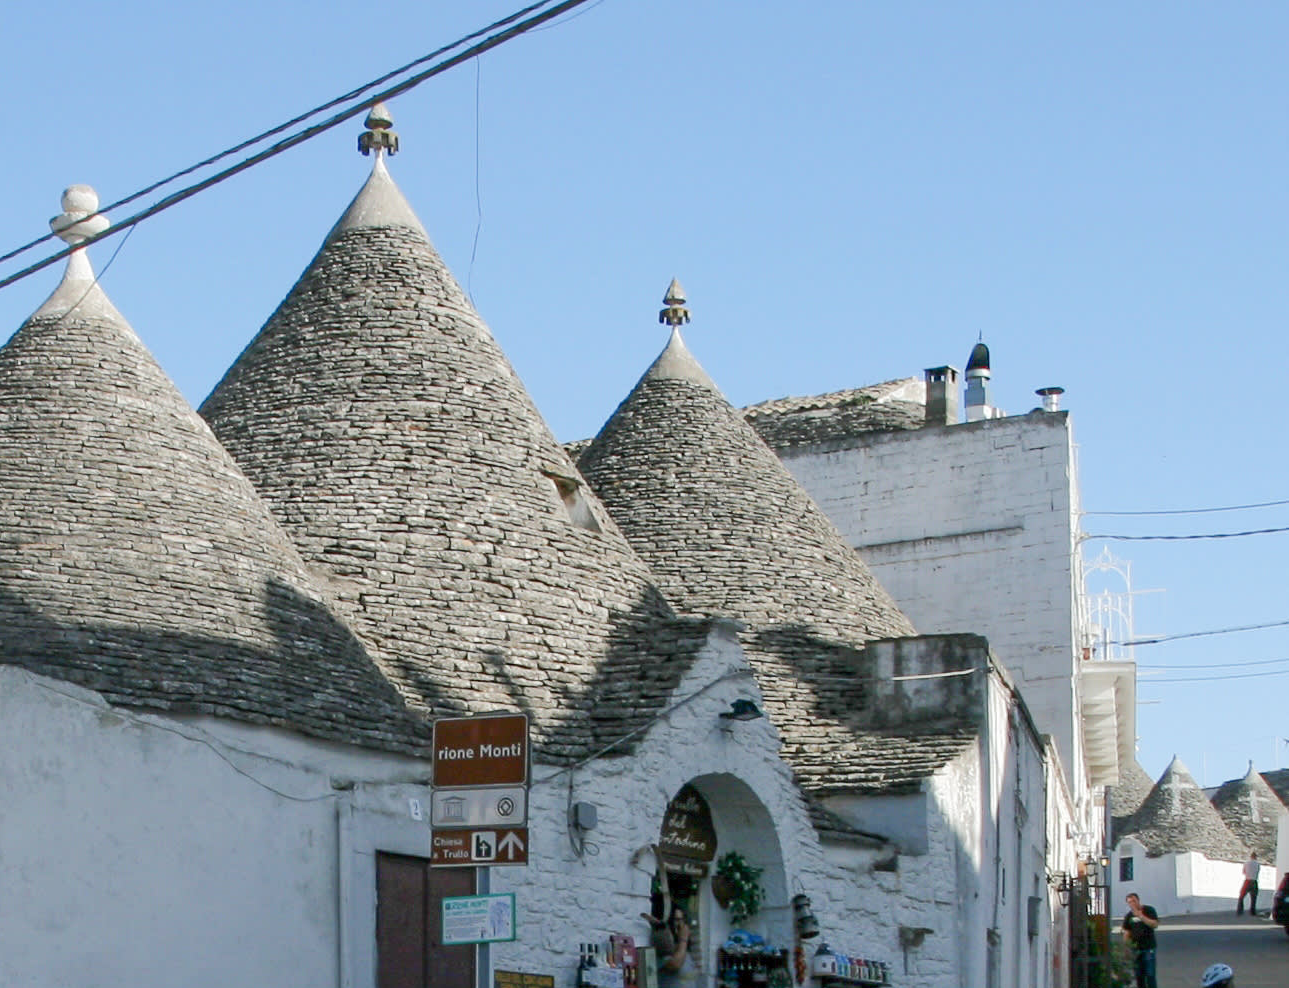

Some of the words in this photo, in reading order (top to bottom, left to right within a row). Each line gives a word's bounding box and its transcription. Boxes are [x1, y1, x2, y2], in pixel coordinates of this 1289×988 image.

[438, 747, 474, 760] rione
[480, 743, 521, 758] Monti
[433, 837, 462, 847] Chiesa
[443, 849, 469, 859] Trullo
